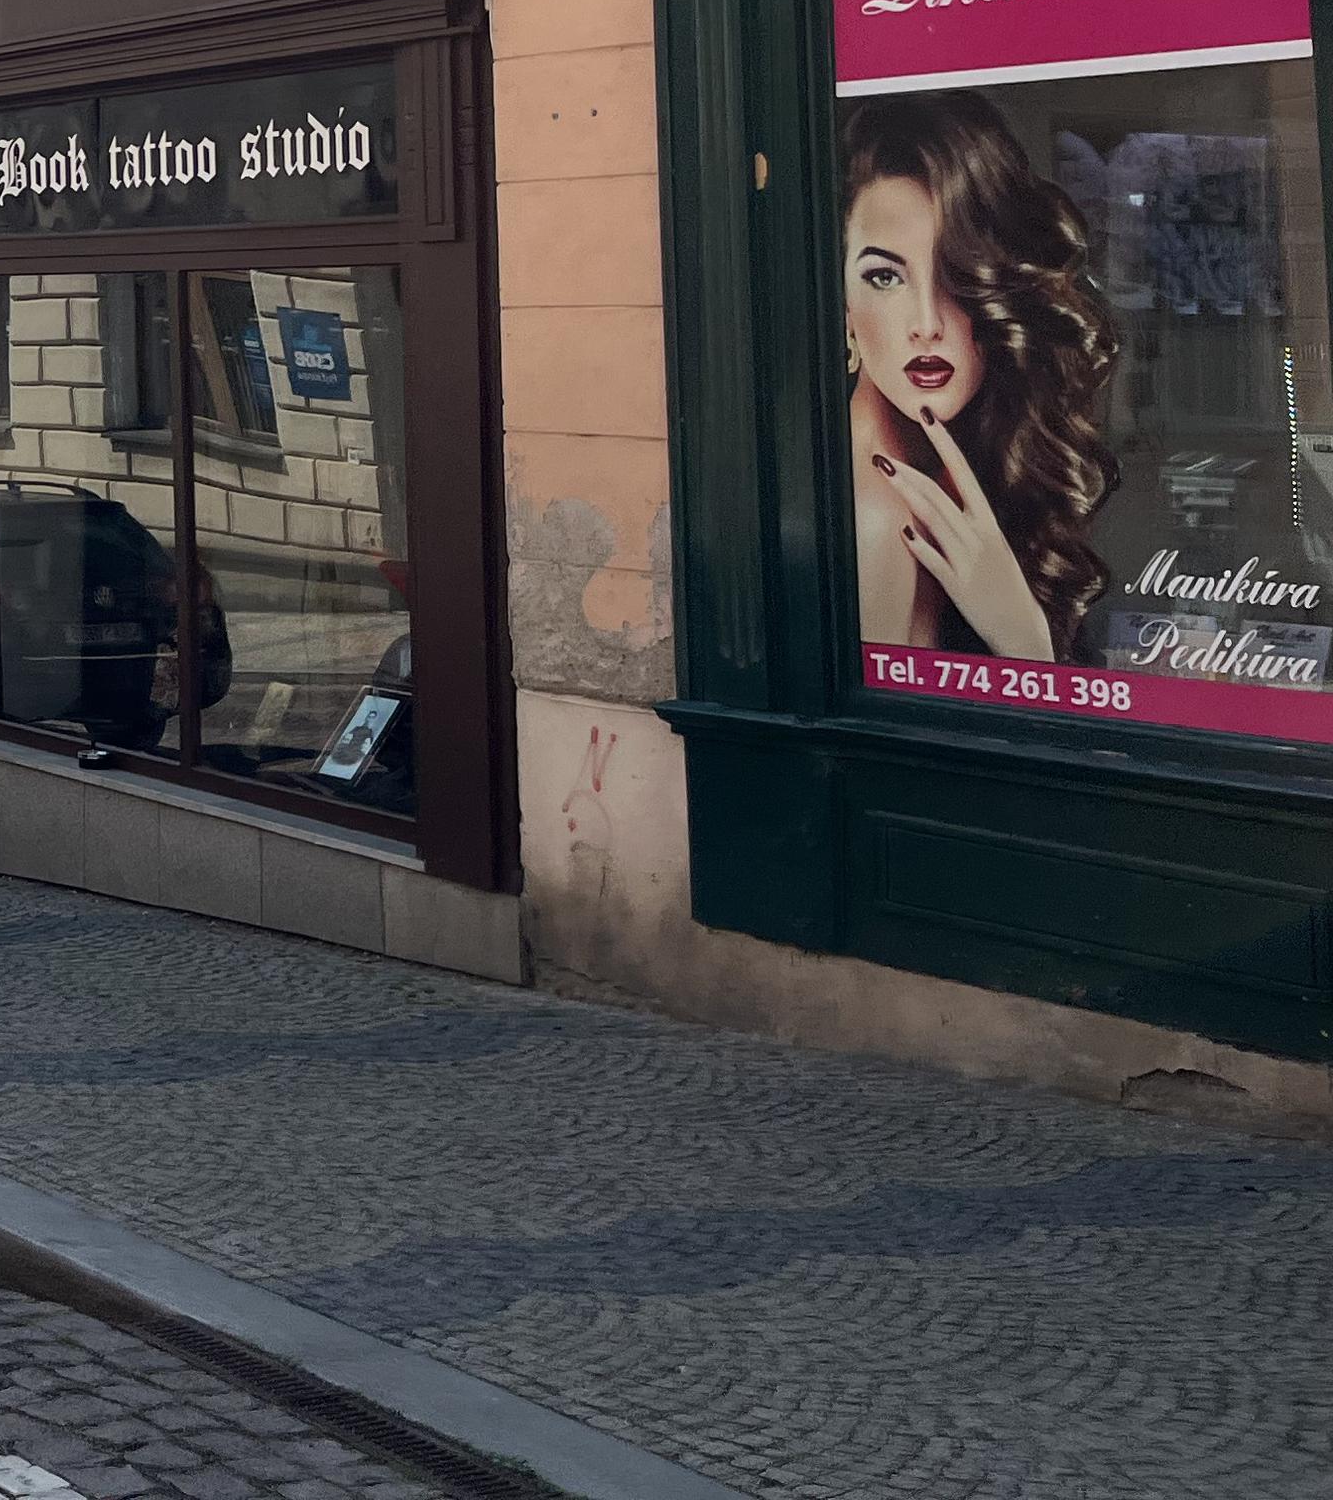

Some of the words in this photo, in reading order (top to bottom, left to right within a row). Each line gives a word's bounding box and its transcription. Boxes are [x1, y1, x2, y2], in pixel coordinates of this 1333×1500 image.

[108, 129, 217, 190] tattoo
[239, 107, 371, 181] studio
[1125, 548, 1320, 610] Manikúra
[870, 652, 924, 685] Tel.
[933, 660, 992, 694] 774
[1000, 667, 1060, 703] 261
[1070, 675, 1132, 712] 398
[1131, 618, 1319, 683] Pedikúra
